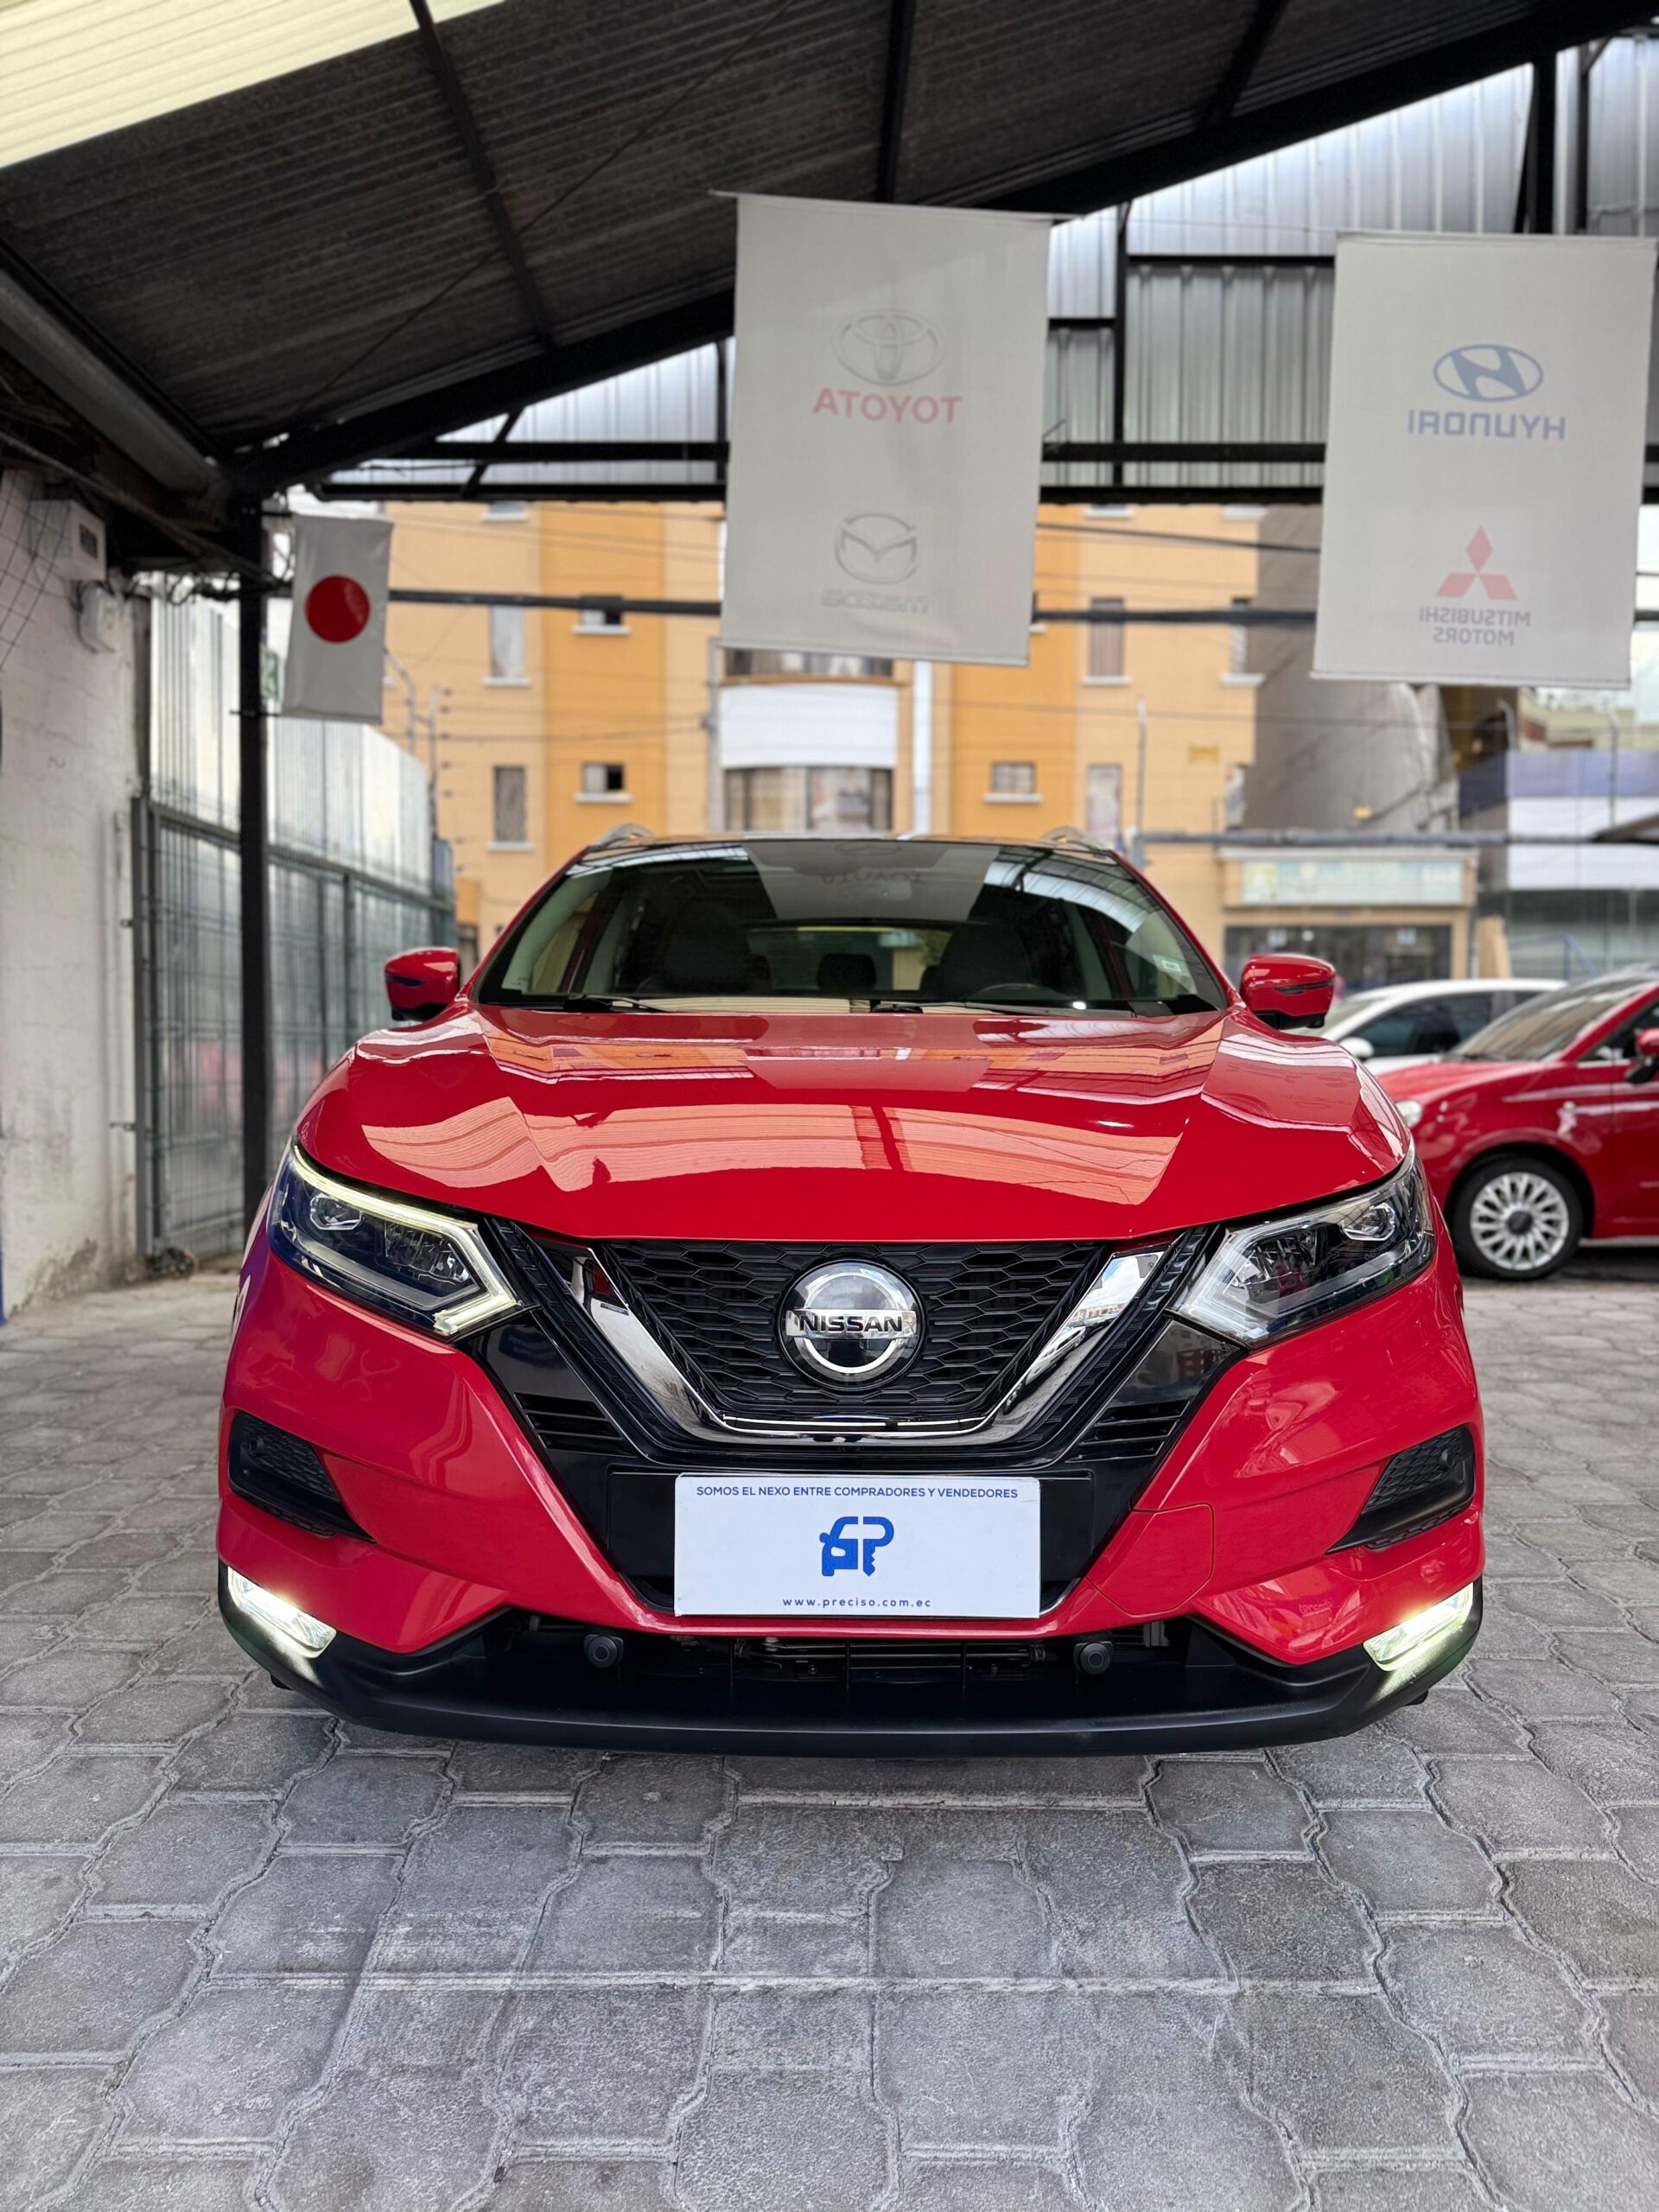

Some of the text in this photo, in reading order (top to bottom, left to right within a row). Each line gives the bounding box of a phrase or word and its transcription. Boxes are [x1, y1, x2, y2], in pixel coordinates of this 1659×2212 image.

[799, 1314, 903, 1332] NISSAN
[696, 1486, 1018, 1498] SOMOS EL NEXO ENTRE COMPRADORES Y VENDEDORES
[782, 1597, 931, 1609] www.preciso.com.ec
